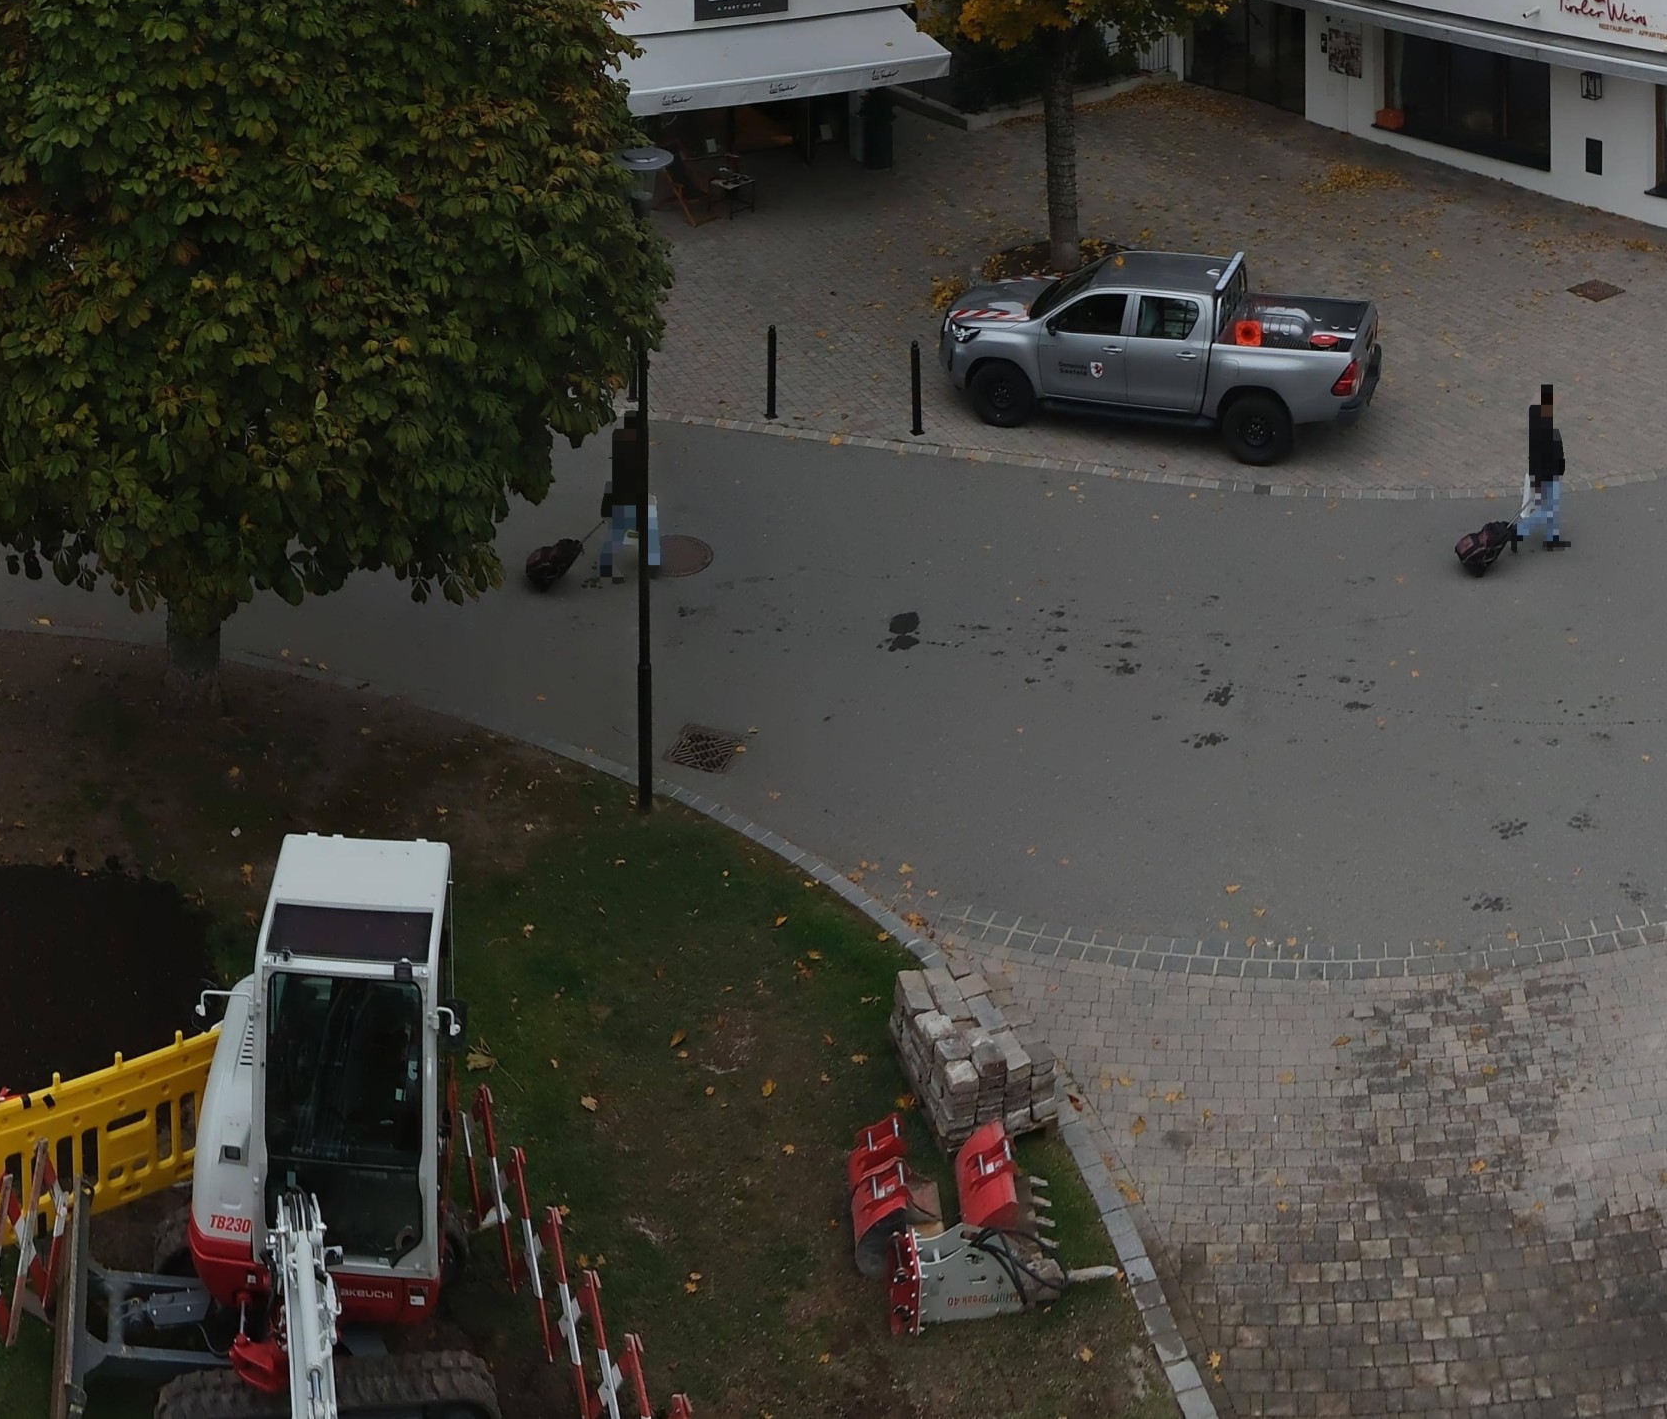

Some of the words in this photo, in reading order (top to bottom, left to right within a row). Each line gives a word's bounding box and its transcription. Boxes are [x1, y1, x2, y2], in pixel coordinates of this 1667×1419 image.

[1599, 23, 1634, 34] RESTAURANT
[209, 1214, 252, 1234] TB230
[340, 1288, 394, 1300] AKEUCHI
